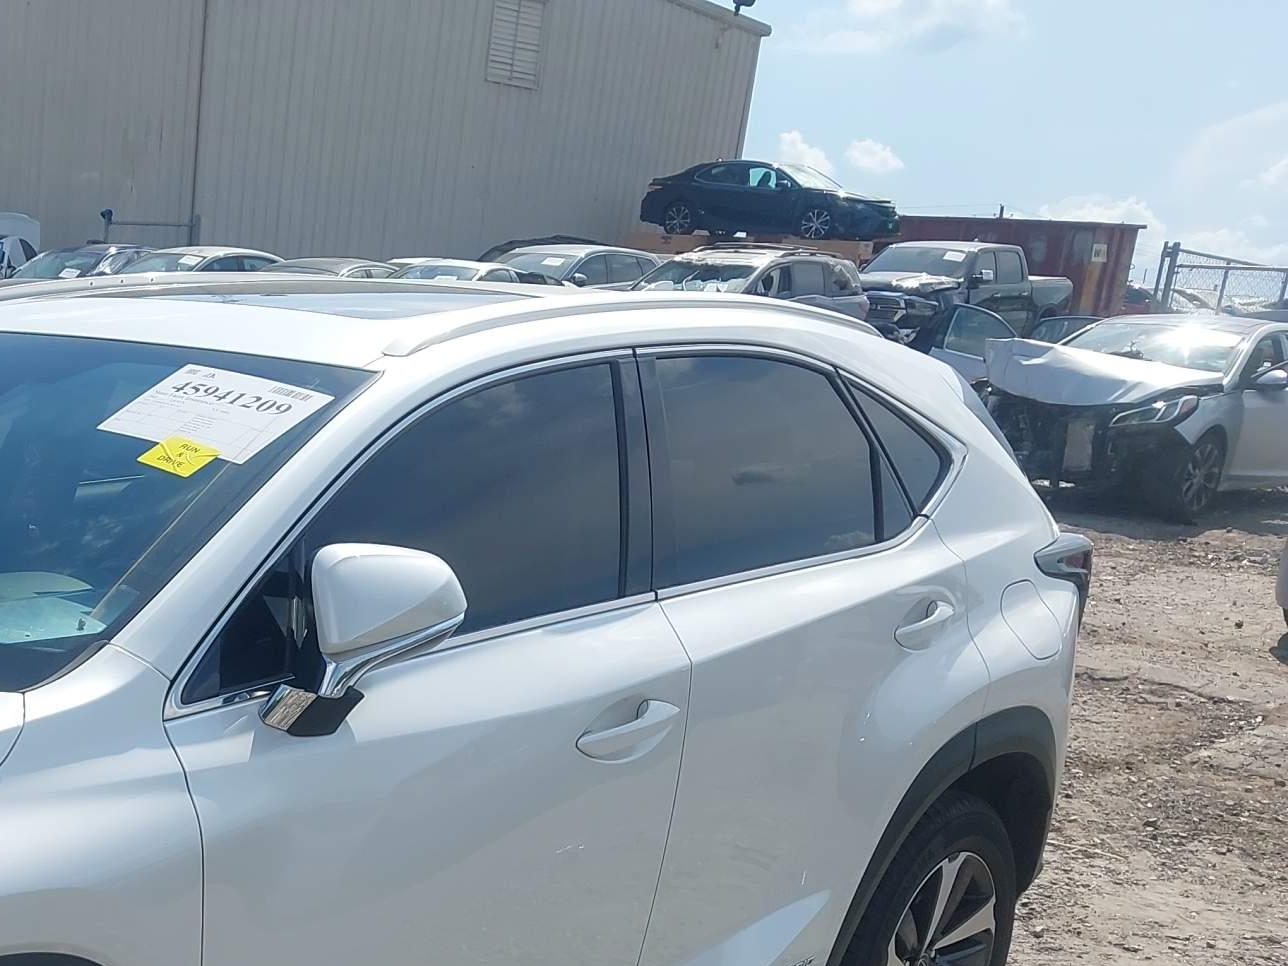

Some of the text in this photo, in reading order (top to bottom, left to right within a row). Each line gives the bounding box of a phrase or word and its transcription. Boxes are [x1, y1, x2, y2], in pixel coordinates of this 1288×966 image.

[172, 381, 293, 415] 45941209
[179, 443, 200, 453] RUN
[156, 455, 185, 468] DRIVE
